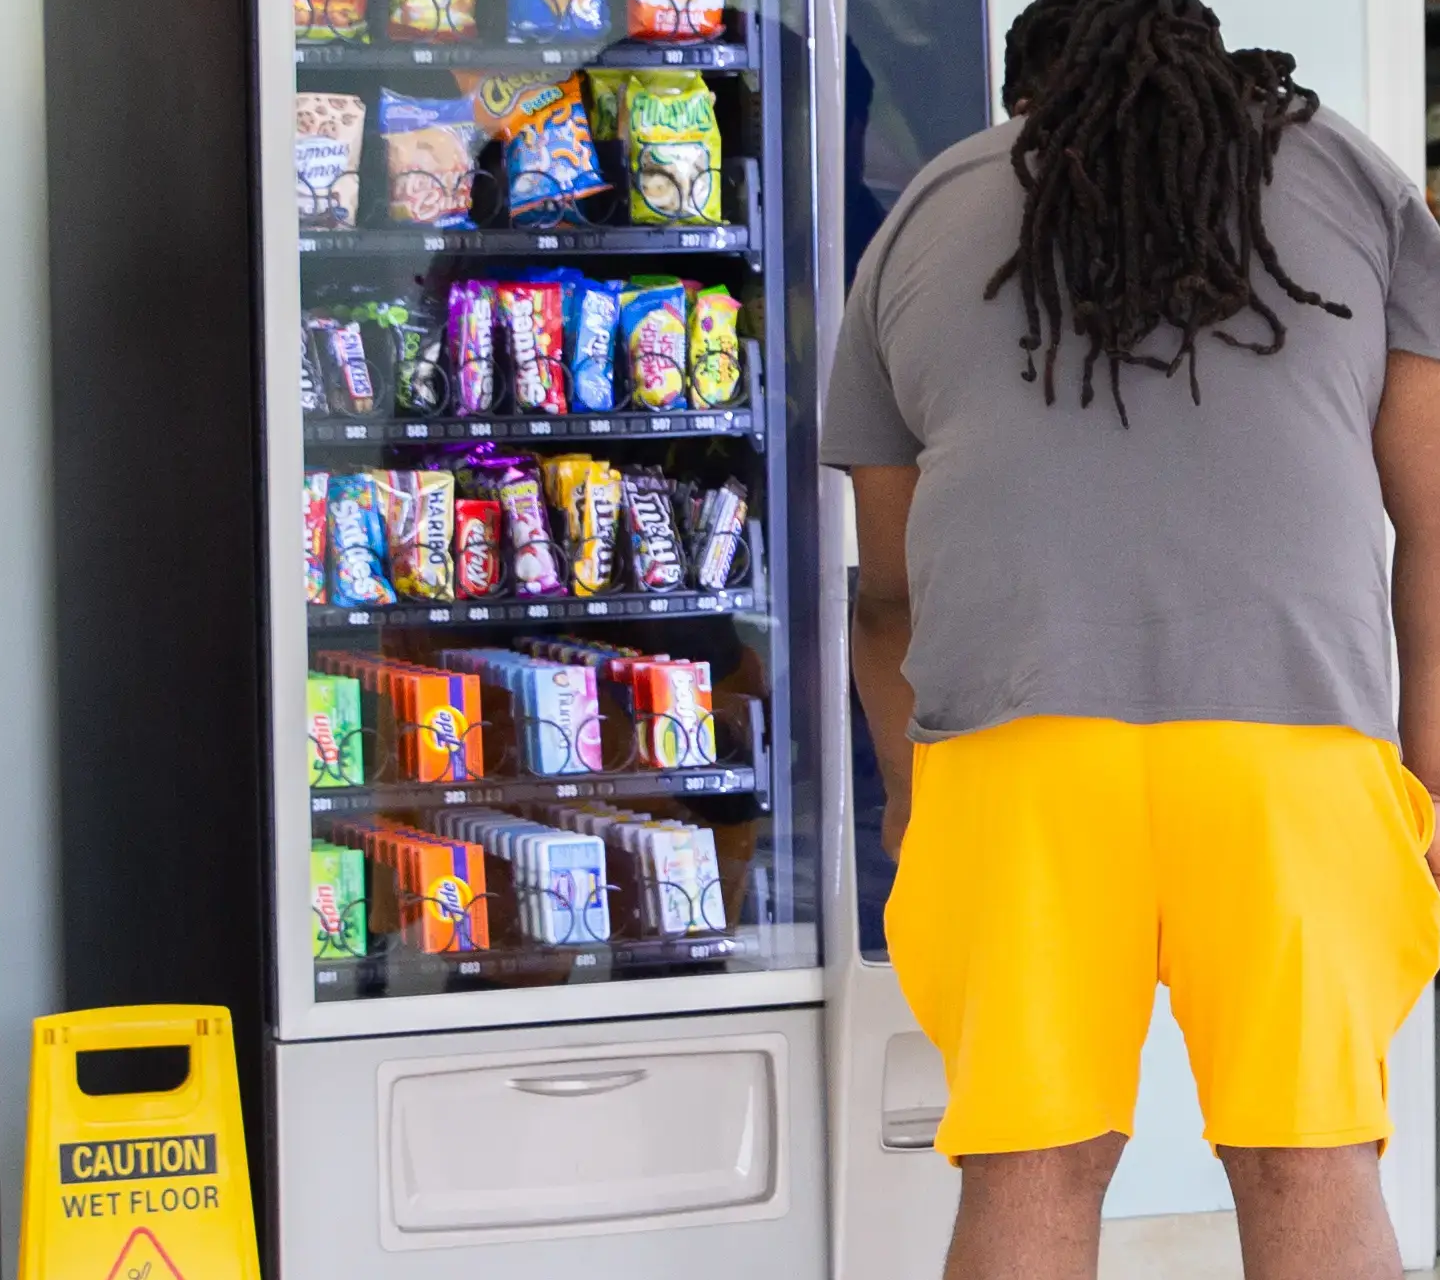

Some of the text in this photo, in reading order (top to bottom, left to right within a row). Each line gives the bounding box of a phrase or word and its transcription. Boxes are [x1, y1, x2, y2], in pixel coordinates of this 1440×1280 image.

[296, 144, 350, 161] amous
[638, 322, 663, 390] Swedish
[329, 499, 375, 595] Skittles
[427, 491, 446, 565] HARIBO
[434, 711, 462, 749] Tide
[439, 881, 467, 919] Tide
[71, 1138, 207, 1181] CAUTION
[61, 1185, 221, 1219] WET FLOOR
